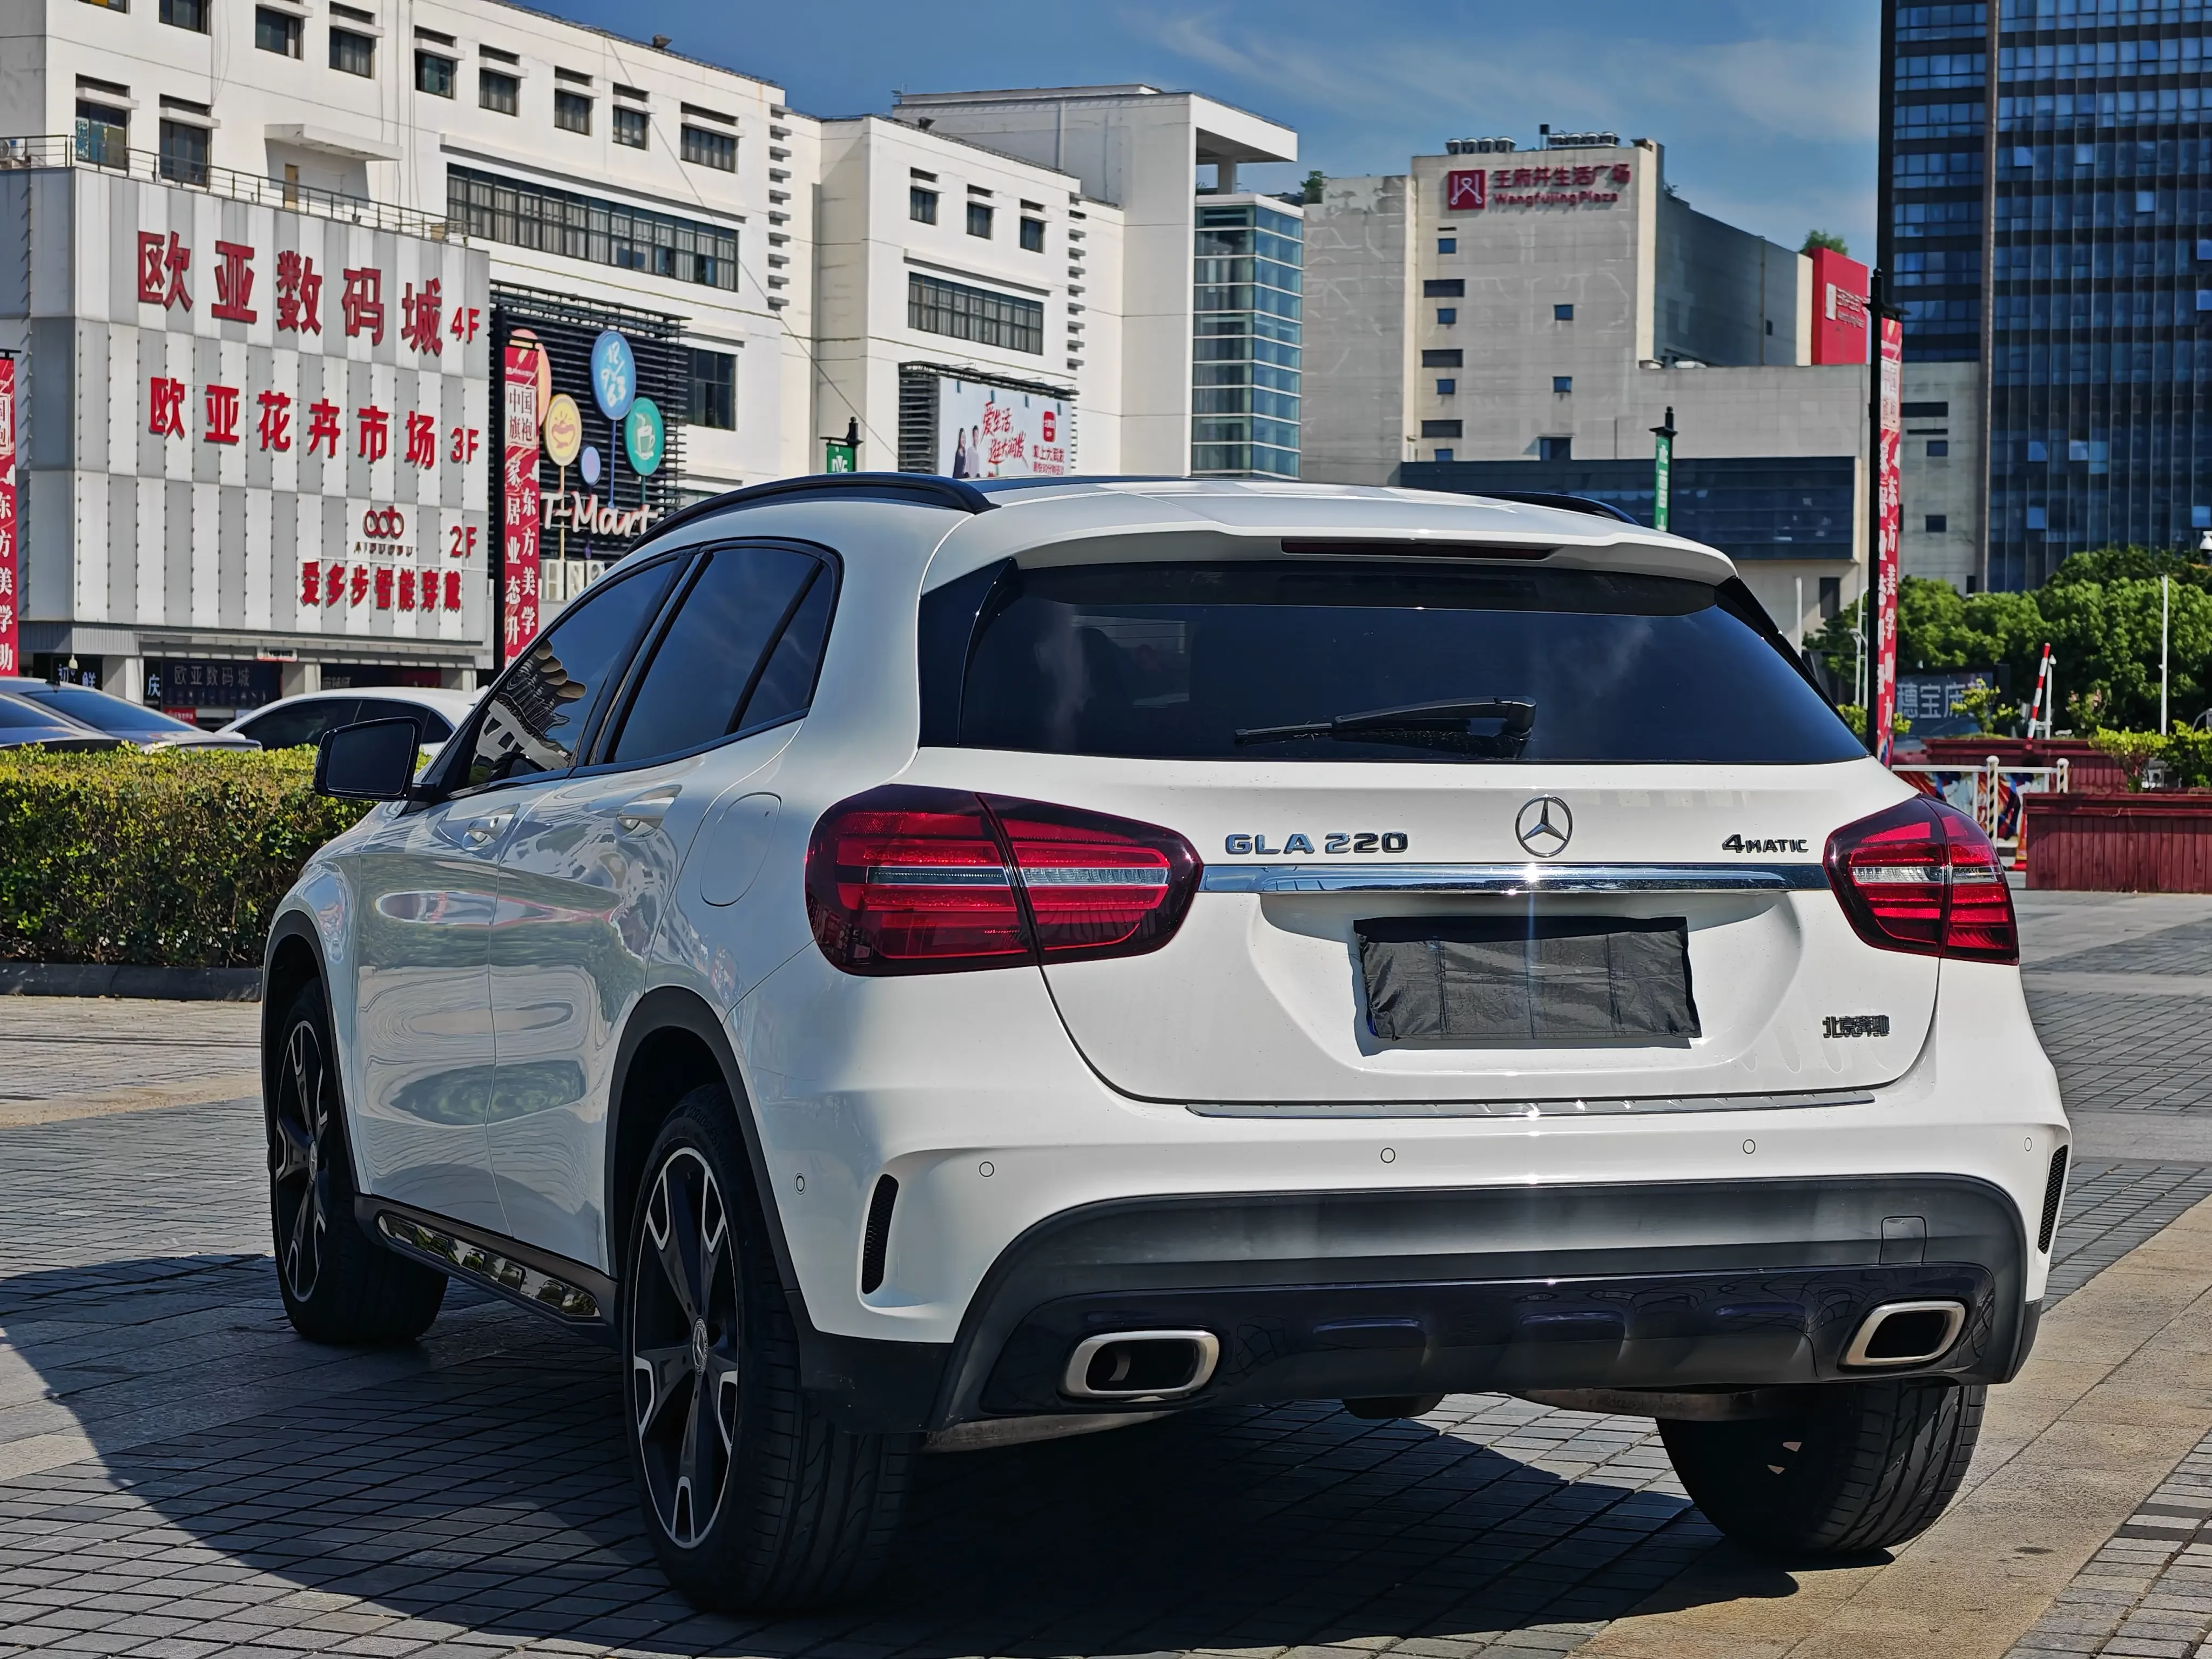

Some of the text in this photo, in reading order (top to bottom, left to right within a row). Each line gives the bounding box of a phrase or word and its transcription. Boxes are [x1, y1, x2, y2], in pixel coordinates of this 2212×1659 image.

[1494, 164, 1630, 188] 王府井生活广场
[1493, 191, 1618, 207] Wangfujing Plaza
[137, 231, 480, 356] 欧亚数码城 4F
[509, 388, 532, 415] 中国
[150, 376, 479, 469] 欧亚花卉市场 3F
[509, 416, 532, 442] 旗袍
[541, 491, 658, 537] T-Mart
[450, 525, 477, 558] 2F
[521, 488, 536, 650] 东方美学
[174, 665, 250, 687] 欧亚数码城
[1224, 832, 1408, 855] GLA 220
[1722, 834, 1809, 854] 4MATIC
